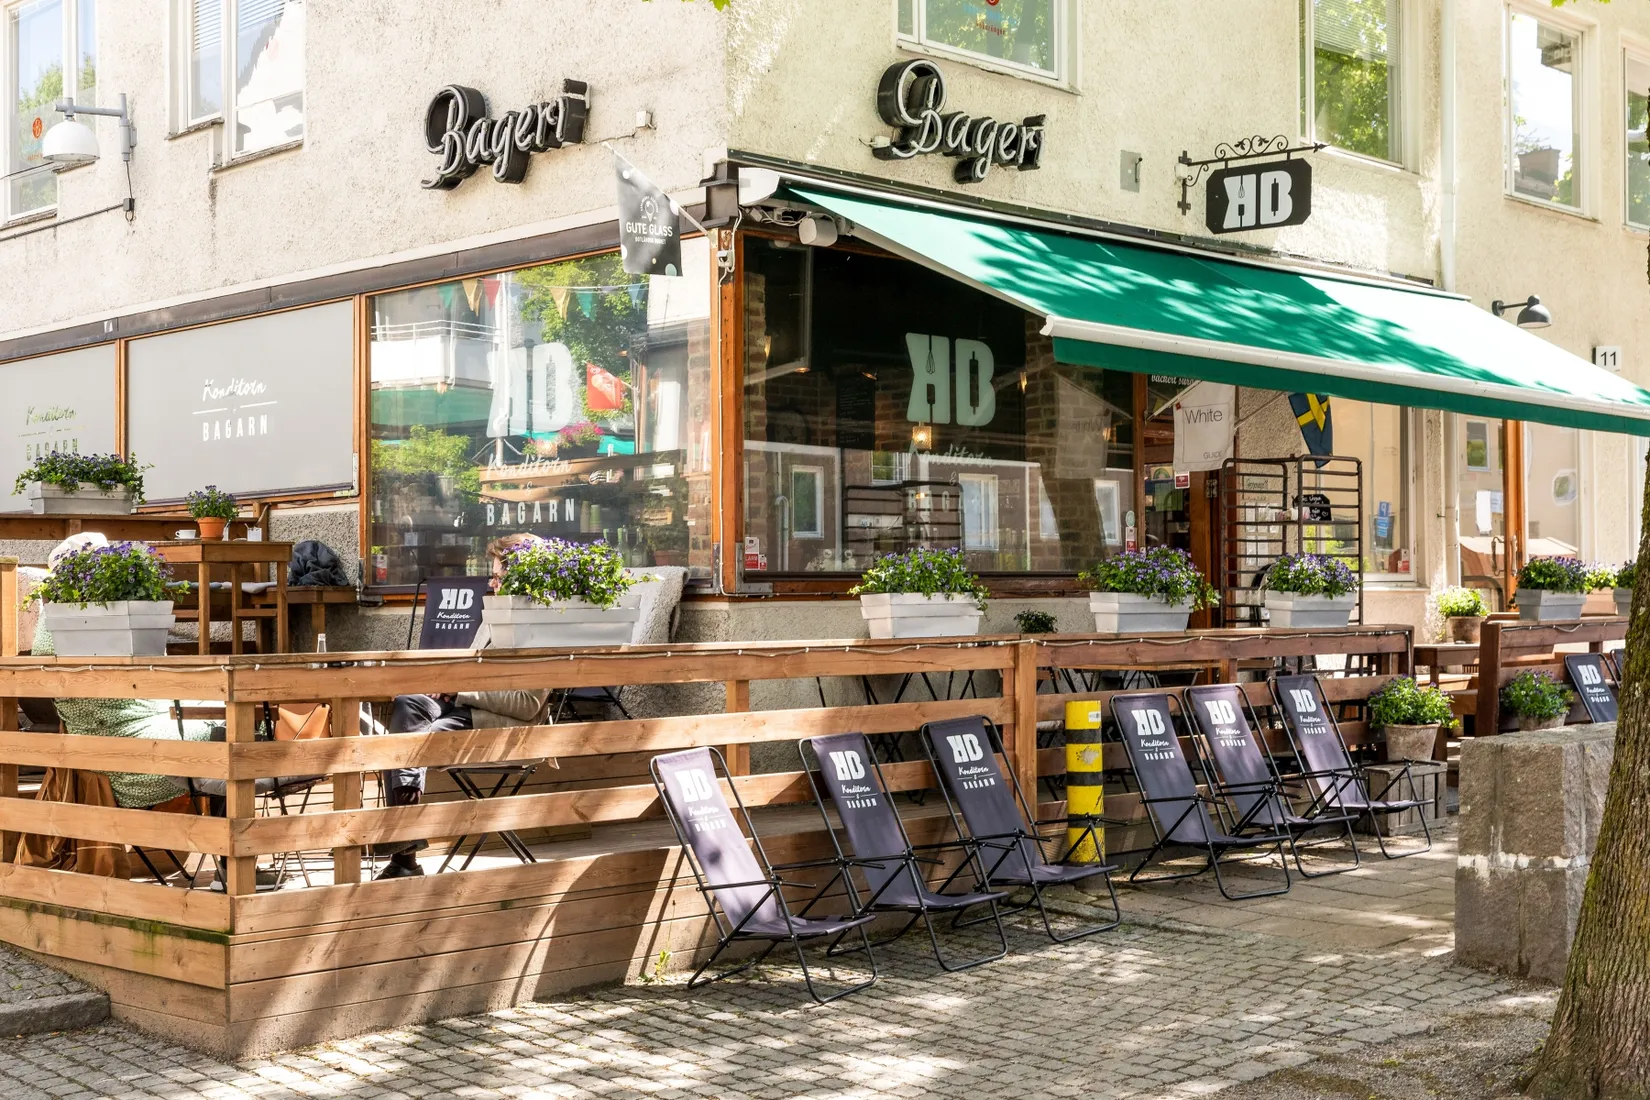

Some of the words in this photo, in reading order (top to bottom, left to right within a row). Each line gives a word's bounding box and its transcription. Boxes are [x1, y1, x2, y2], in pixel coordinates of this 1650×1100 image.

[874, 58, 1047, 184] Bageri
[420, 78, 588, 190] Bageri
[626, 221, 648, 234] GUTE
[649, 224, 673, 237] GLASS
[1600, 351, 1616, 366] 11
[202, 377, 267, 402] Konditorn
[202, 414, 268, 441] BAGARN
[1185, 408, 1223, 424] White
[1203, 452, 1223, 460] GUIDE
[486, 498, 575, 526] BAGARN
